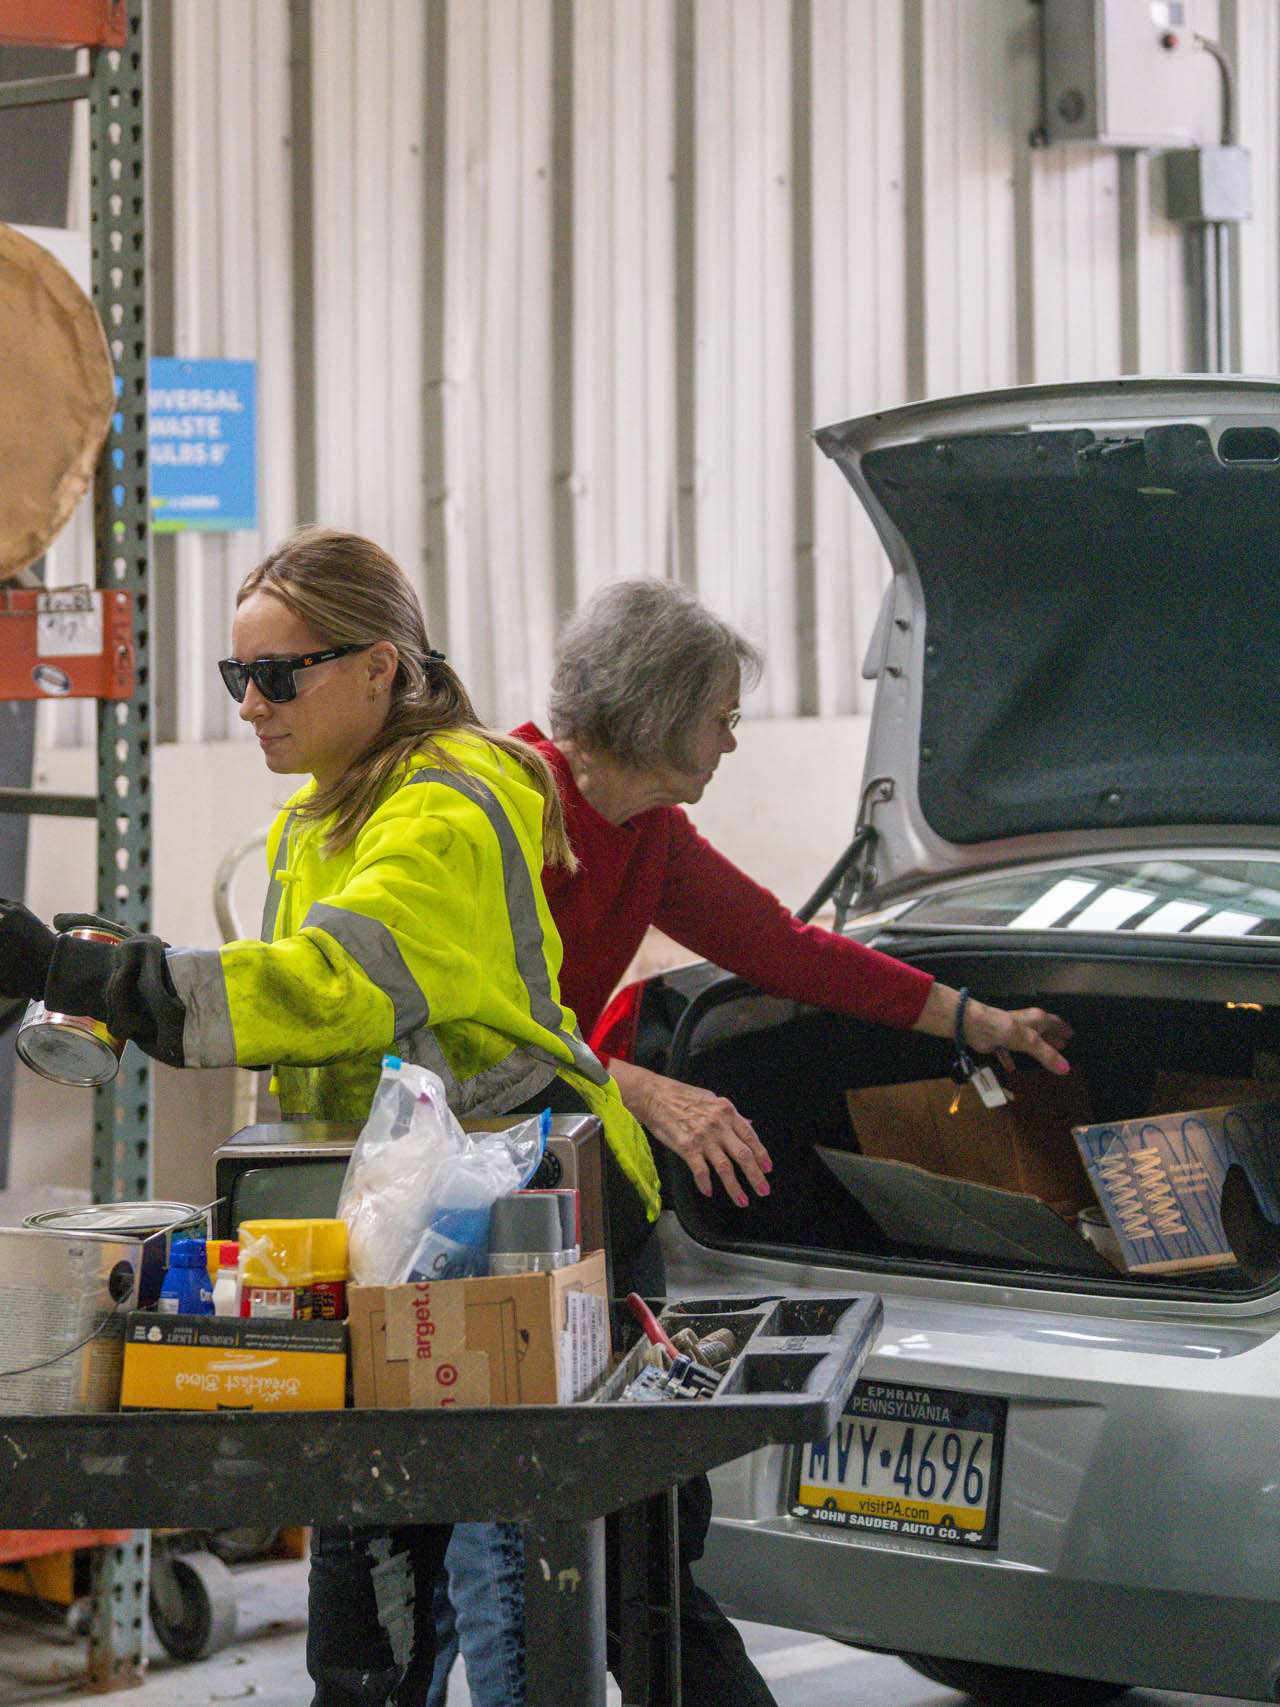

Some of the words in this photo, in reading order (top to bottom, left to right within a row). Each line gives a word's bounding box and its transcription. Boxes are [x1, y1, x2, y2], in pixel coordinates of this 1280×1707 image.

[149, 389, 245, 412] IVERSAL
[175, 1371, 220, 1393] Blend
[225, 1372, 301, 1396] Breakfast
[867, 1385, 931, 1404] EPHRATA
[851, 1396, 951, 1423] PENNSYLVANIA
[859, 1498, 930, 1521] visitPA.com
[812, 1509, 846, 1523] JOHN
[849, 1513, 898, 1531] SAUDER
[901, 1522, 935, 1536] AUTO
[938, 1527, 961, 1540] CO.
